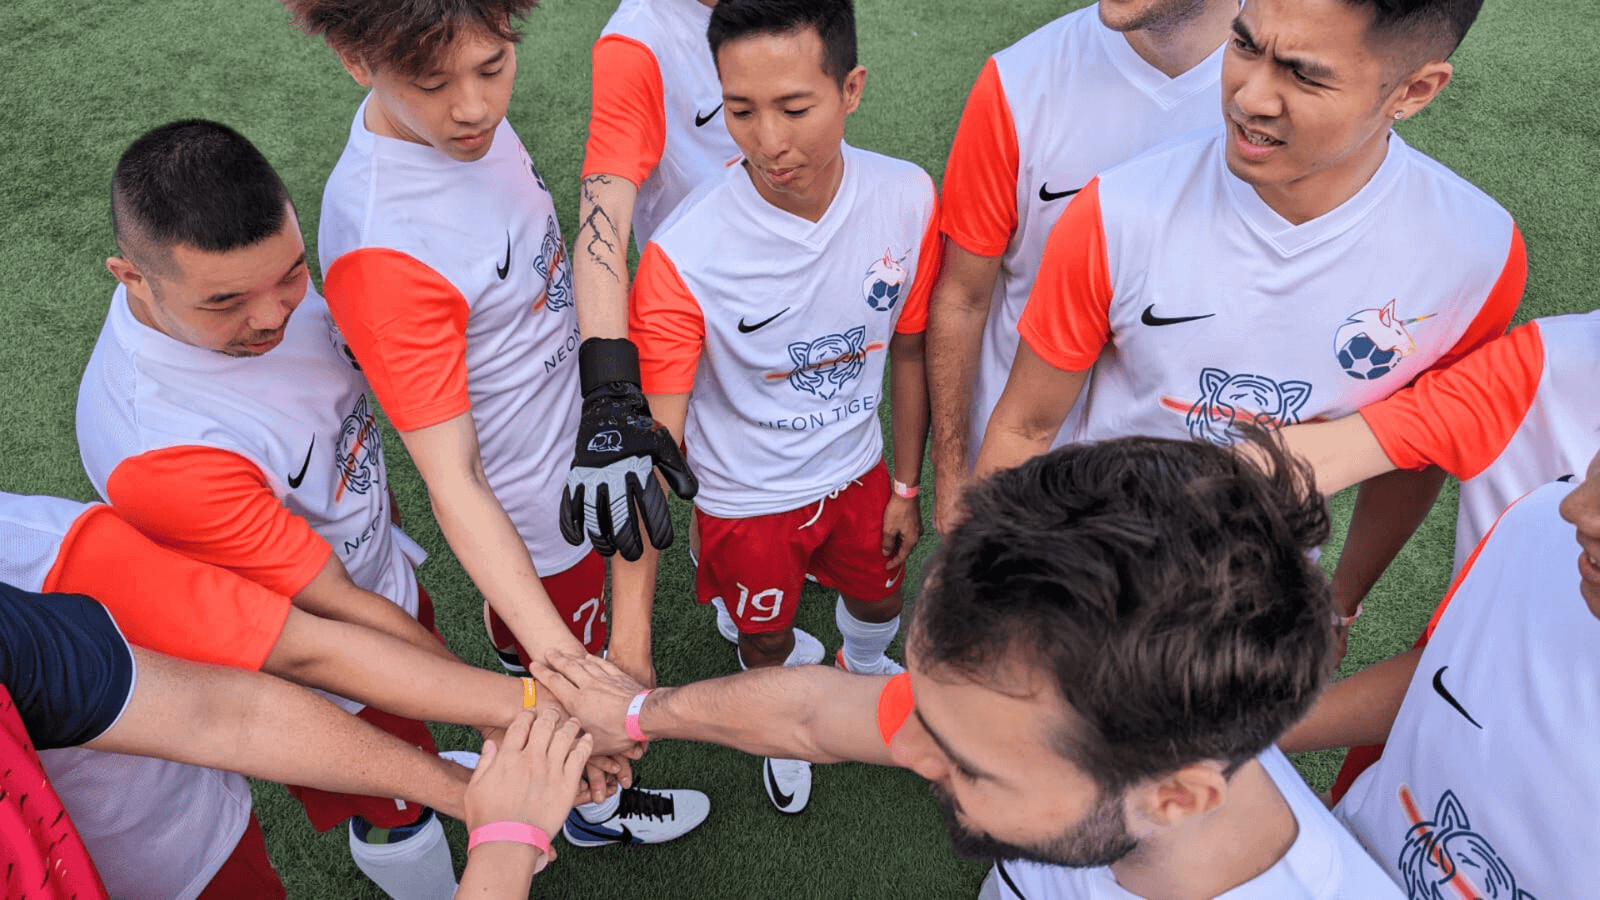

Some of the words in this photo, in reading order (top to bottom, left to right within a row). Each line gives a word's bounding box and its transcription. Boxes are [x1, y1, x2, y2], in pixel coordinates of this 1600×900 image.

[832, 395, 879, 421] TIGE
[573, 583, 606, 645] 7
[736, 582, 784, 621] 19
